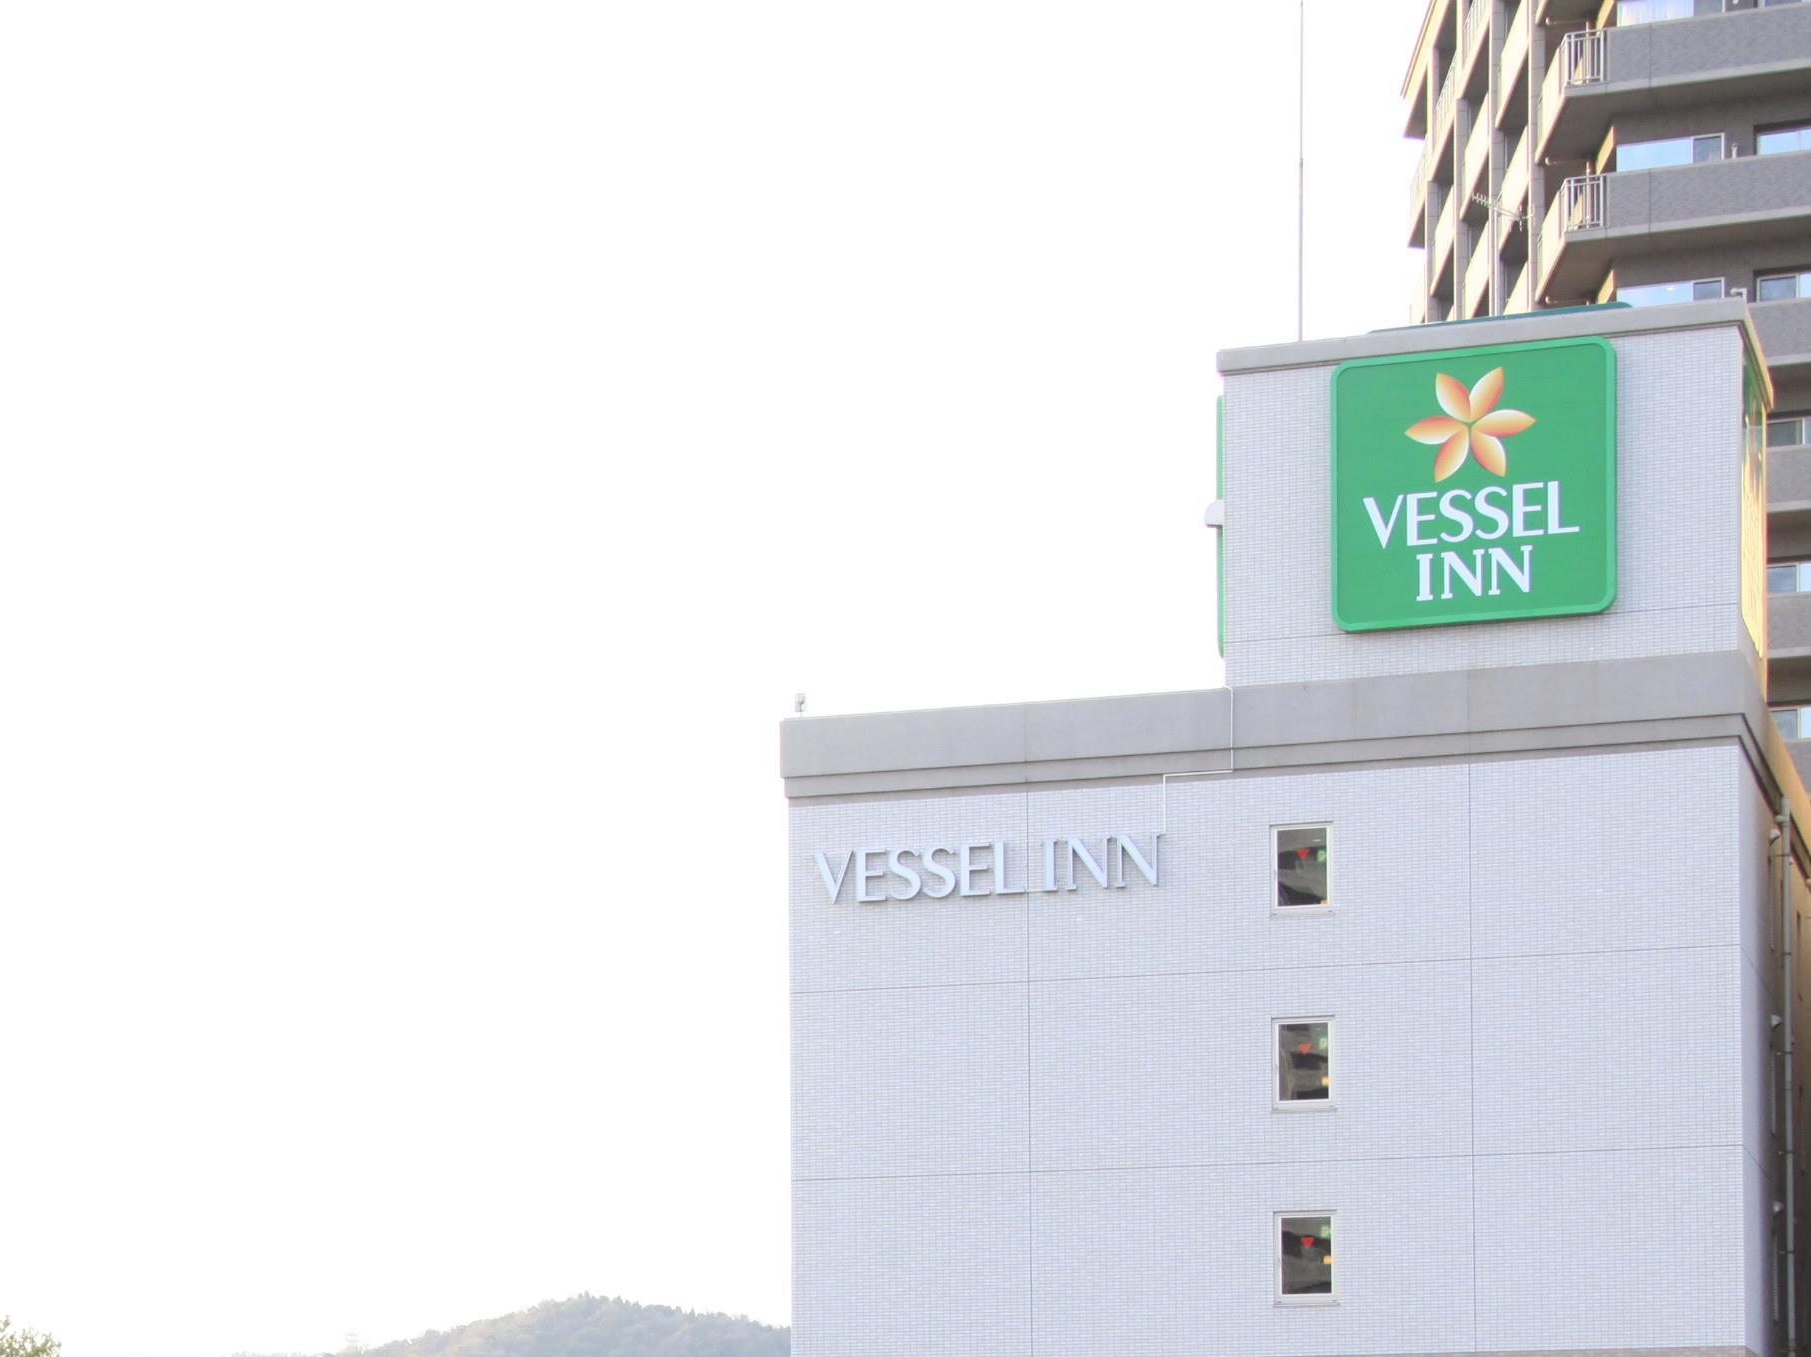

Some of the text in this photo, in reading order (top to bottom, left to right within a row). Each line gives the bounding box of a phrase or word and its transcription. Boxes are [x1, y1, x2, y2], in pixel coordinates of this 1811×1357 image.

[1362, 481, 1580, 549] VESSEL
[1416, 545, 1533, 601] INN
[814, 831, 1166, 905] VESSEL INN
